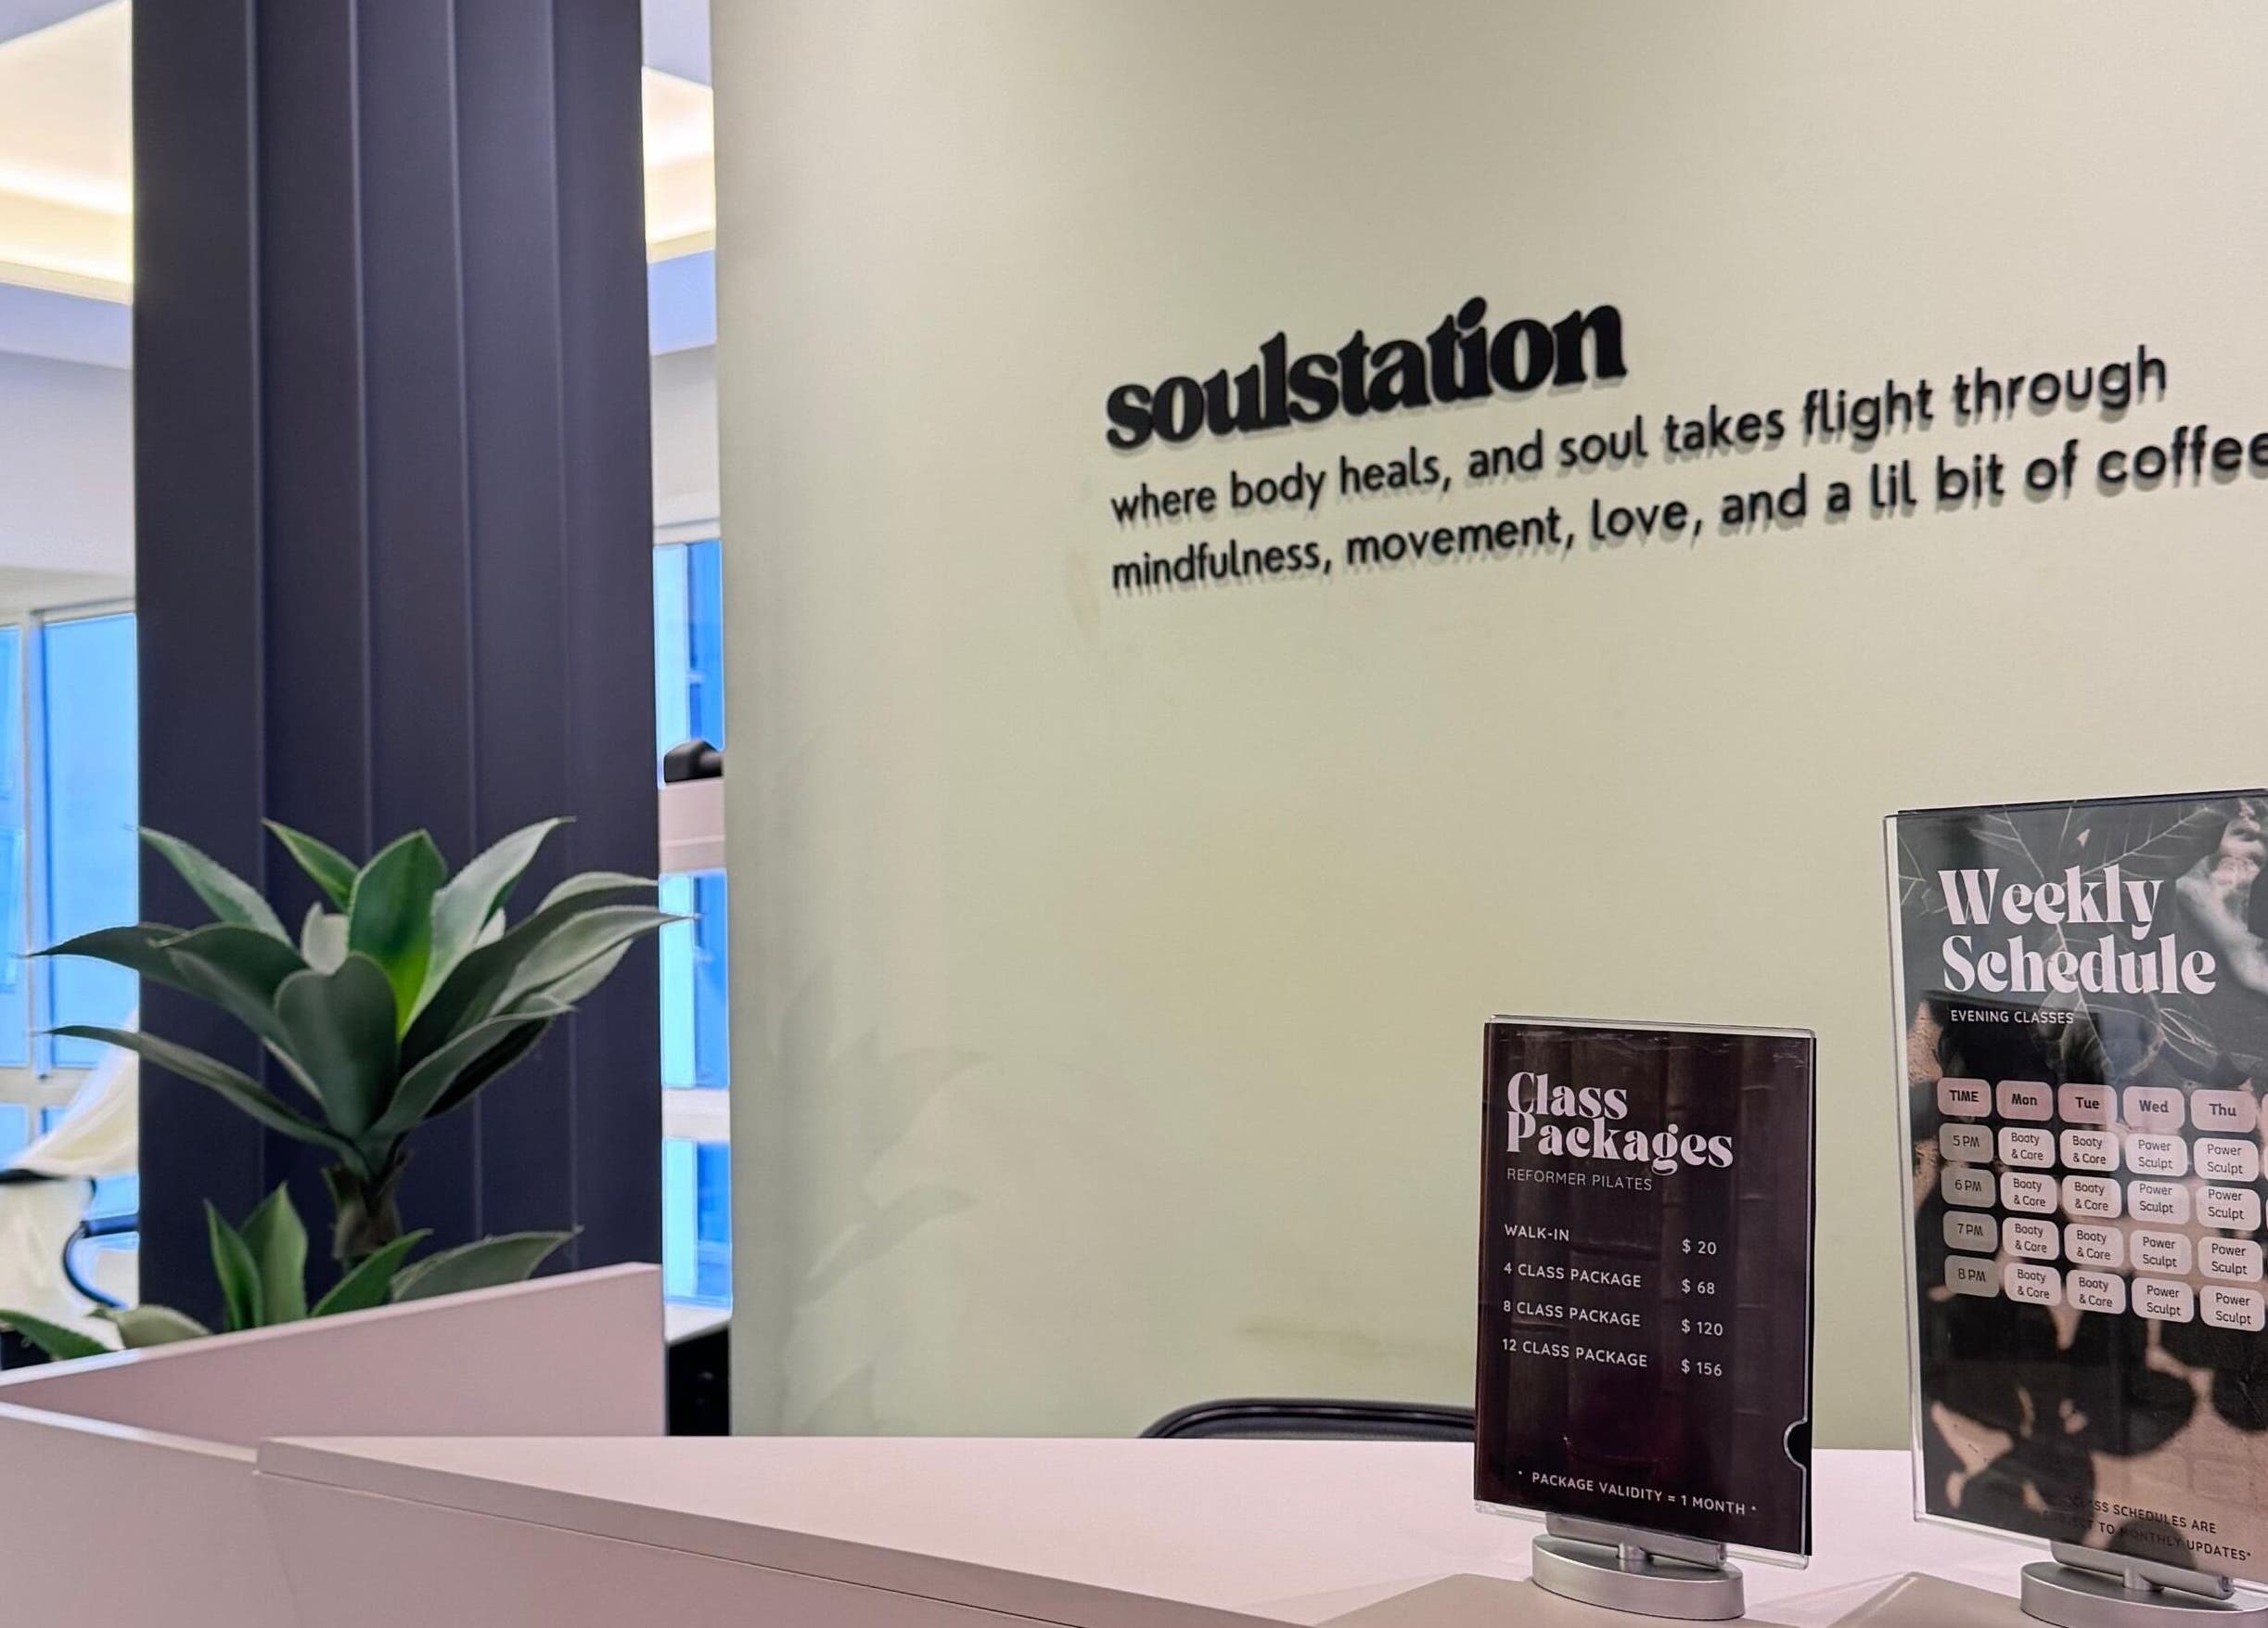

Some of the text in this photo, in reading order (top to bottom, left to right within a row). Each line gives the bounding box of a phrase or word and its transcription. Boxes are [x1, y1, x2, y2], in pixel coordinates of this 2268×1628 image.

[1106, 296, 1627, 450] soulstation
[1111, 344, 2166, 523] where body heals, and soul takes flight through
[1113, 424, 2268, 589] mindfulness, movement, love, and a lil bit of coffee
[1937, 864, 2164, 941] Weekly
[1941, 933, 2216, 994] Schedule
[1951, 1009, 2074, 1025] EVENING CLASSES
[1507, 1071, 1628, 1120] Class
[1949, 1089, 1980, 1103] TIME
[2011, 1093, 2038, 1106] Mon
[2075, 1096, 2100, 1109] Tue
[2139, 1099, 2169, 1113] Wed
[2209, 1103, 2236, 1117] Thu
[1506, 1110, 1734, 1176] Packages
[1953, 1135, 1980, 1148] 5 PM
[2011, 1132, 2040, 1147] Booty
[2072, 1135, 2103, 1150] Booty
[2138, 1139, 2171, 1150] Power
[2011, 1148, 2044, 1160] & Core
[2207, 1144, 2242, 1156] Power
[2073, 1153, 2107, 1164] & Core
[2138, 1157, 2173, 1171] Sculpt
[2208, 1161, 2243, 1175] Sculpt
[1507, 1168, 1652, 1191] REFORMER PILATES
[1954, 1179, 1982, 1192] 6 PM
[2013, 1178, 2042, 1193] Booty
[2074, 1182, 2105, 1196] Booty
[2139, 1183, 2172, 1196] Power
[2208, 1188, 2243, 1201] Power
[2014, 1195, 2046, 1207] & Core
[2075, 1199, 2108, 1211] & Core
[2139, 1200, 2174, 1214] Sculpt
[2208, 1206, 2245, 1222] Sculpt
[1956, 1224, 1983, 1237] 7 PM
[2015, 1224, 2044, 1238] Booty
[2077, 1230, 2107, 1245] Booty
[1504, 1224, 1717, 1255] WALK-IN $ 20
[2015, 1239, 2047, 1253] & Core
[2143, 1237, 2176, 1250] Power
[2077, 1247, 2111, 1261] & Core
[2211, 1243, 2246, 1256] Power
[2143, 1254, 2177, 1269] Sculpt
[2211, 1261, 2248, 1275] Sculpt
[1504, 1263, 1715, 1294] 4 CLASS PACKAGE $ 68
[1958, 1268, 1986, 1283] 8 PM
[2017, 1269, 2046, 1284] Booty
[2079, 1276, 2108, 1292] Booty
[2018, 1286, 2050, 1300] & Core
[2146, 1285, 2180, 1298] Power
[2079, 1294, 2113, 1307] & Core
[2215, 1292, 2250, 1306] Power
[2146, 1302, 2181, 1316] Sculpt
[1503, 1300, 1723, 1337] 8 CLASS PACKAGE $ 120
[2215, 1311, 2251, 1326] Sculpt
[1502, 1339, 1723, 1377] 12 CLASS PACKAGE $ 156
[1531, 1471, 1594, 1492] PACKAGE
[1598, 1481, 1662, 1502] VALIDITY
[1681, 1494, 1687, 1506] 1
[1692, 1496, 1746, 1515] MONTH
[2113, 1504, 2186, 1528] SCHEDULES
[2191, 1519, 2217, 1534] ARE
[2099, 1521, 2115, 1535] TO
